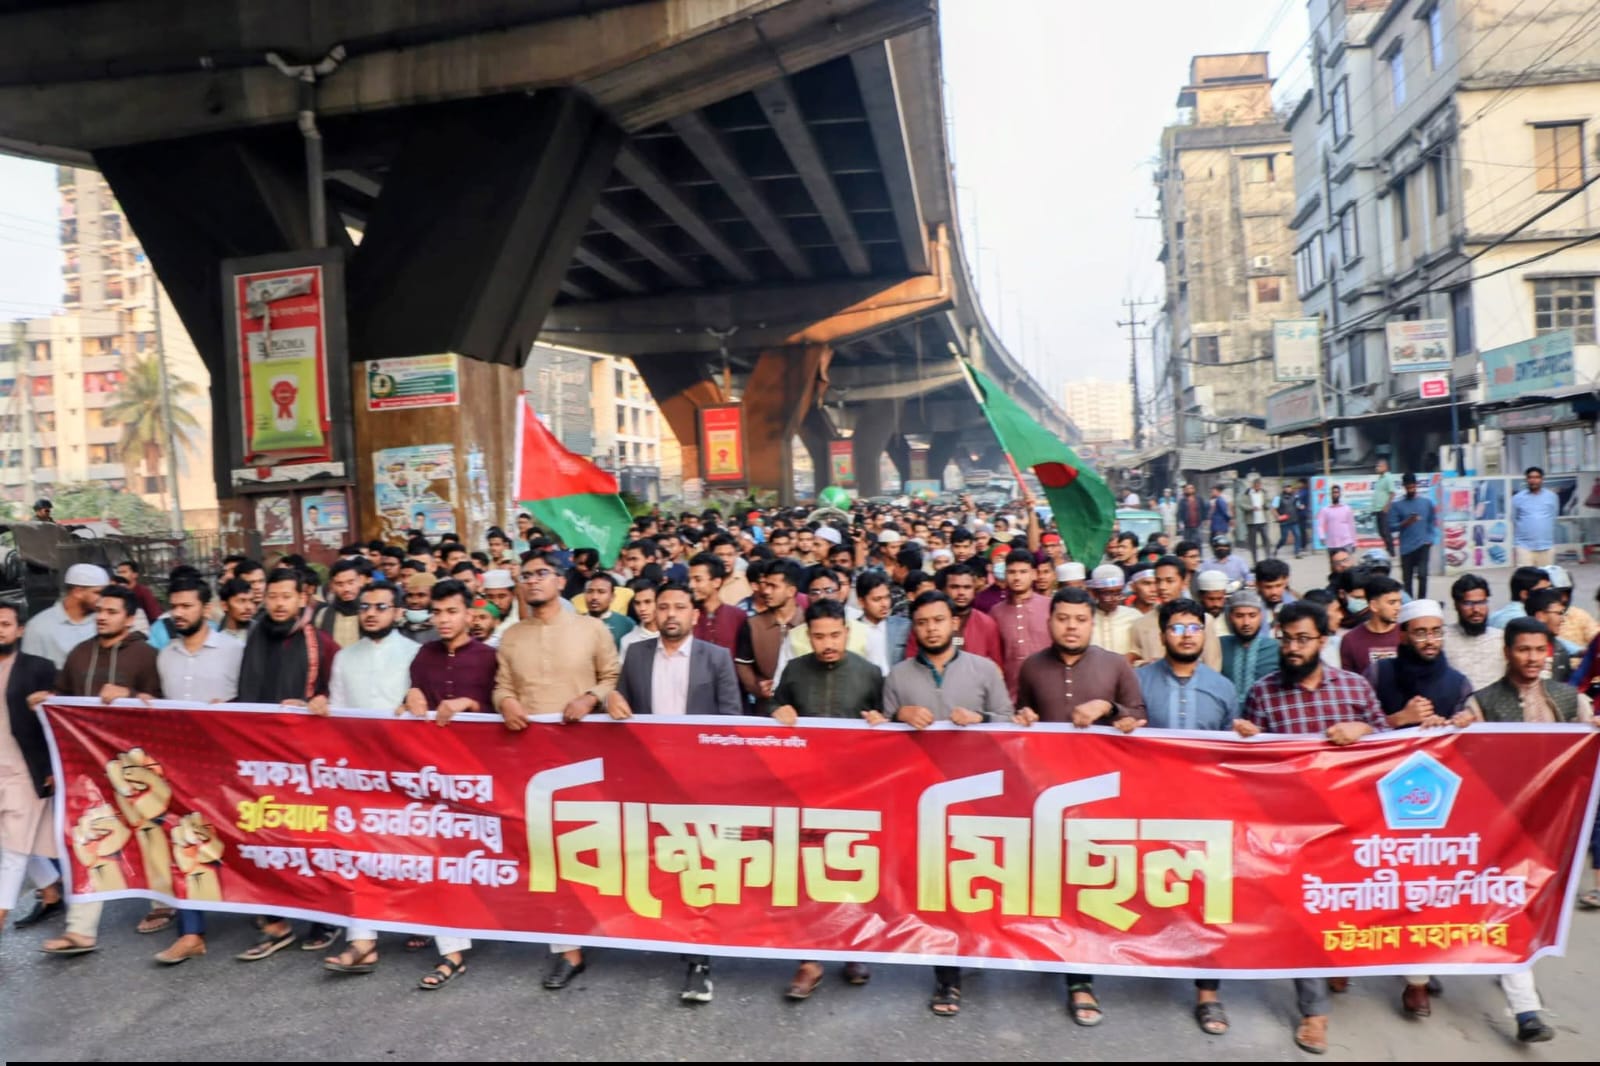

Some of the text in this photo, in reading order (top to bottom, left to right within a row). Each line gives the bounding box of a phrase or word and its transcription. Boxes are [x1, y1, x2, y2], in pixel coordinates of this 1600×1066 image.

[311, 758, 391, 793] নির্বাচন
[391, 766, 493, 803] স্থগিতের
[236, 795, 503, 853] প্রতিবাদে ও অনতিবিলম্বে
[525, 757, 1233, 932] বিক্ষোভ মিছিল
[438, 850, 519, 887] দাবিতে
[1352, 833, 1481, 868] বাংলাদেশ
[1302, 867, 1528, 914] ইসলামী ছাত্রশিবির
[1322, 922, 1510, 951] চট্টগ্রাম মহানগর
